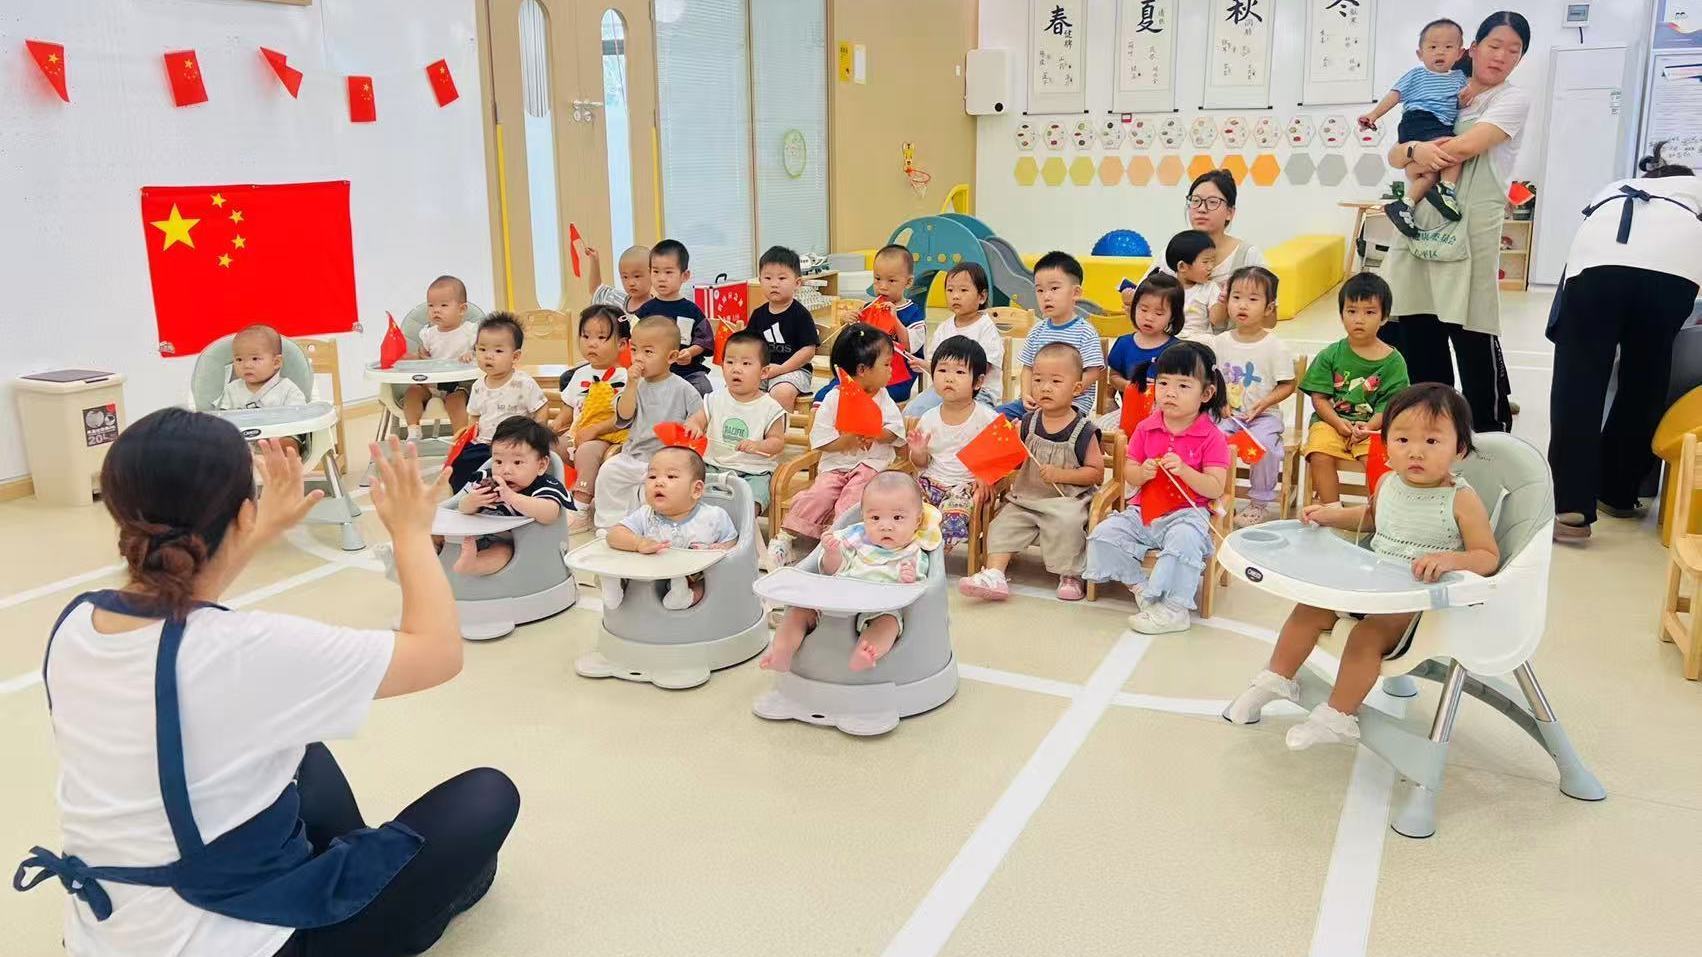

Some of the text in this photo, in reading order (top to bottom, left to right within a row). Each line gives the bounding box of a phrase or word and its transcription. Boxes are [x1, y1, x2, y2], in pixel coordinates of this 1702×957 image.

[1044, 5, 1073, 35] 春
[1136, 0, 1164, 33] 夏
[1225, 0, 1262, 25] 秋
